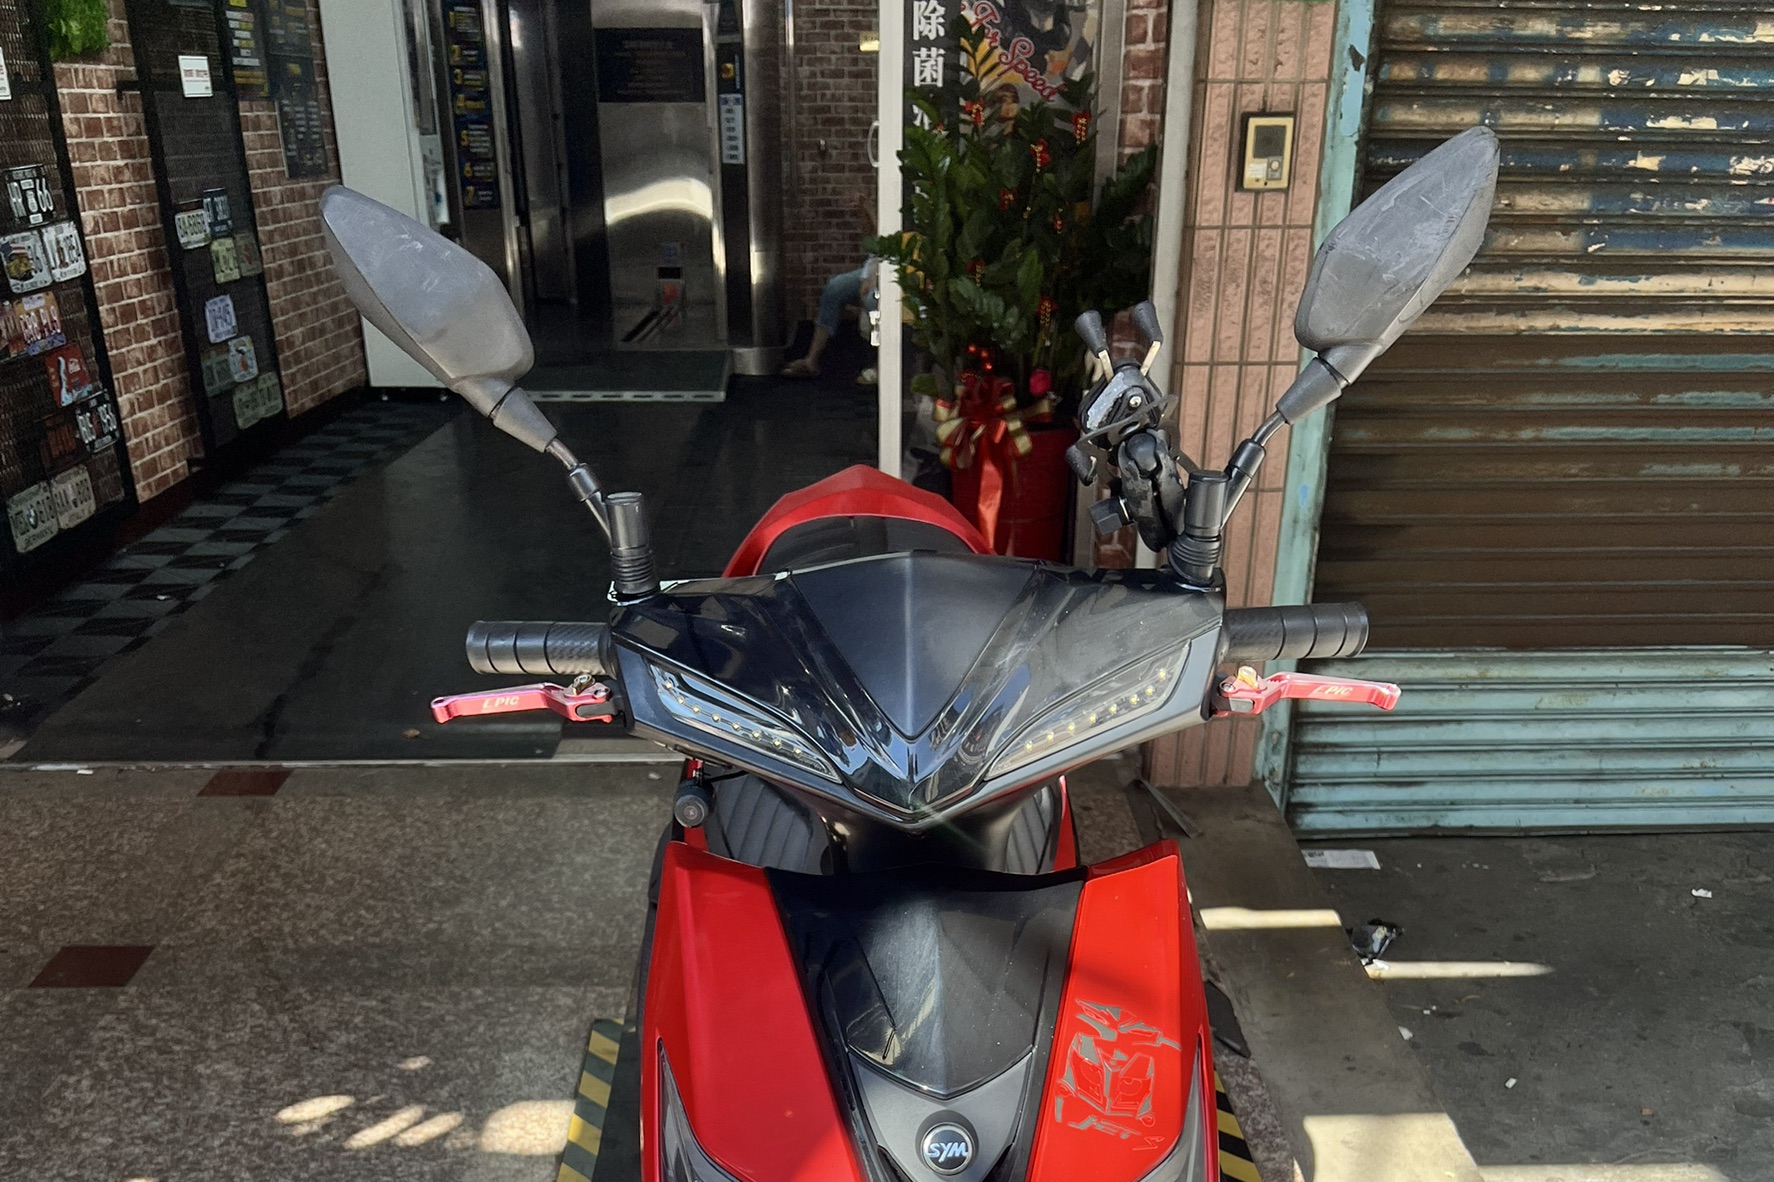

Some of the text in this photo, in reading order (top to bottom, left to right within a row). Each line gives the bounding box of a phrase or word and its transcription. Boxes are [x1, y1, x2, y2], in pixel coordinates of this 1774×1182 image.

[453, 69, 463, 85] 3
[997, 38, 1068, 103] Speed
[36, 178, 54, 212] 66
[926, 1141, 969, 1163] SYM
